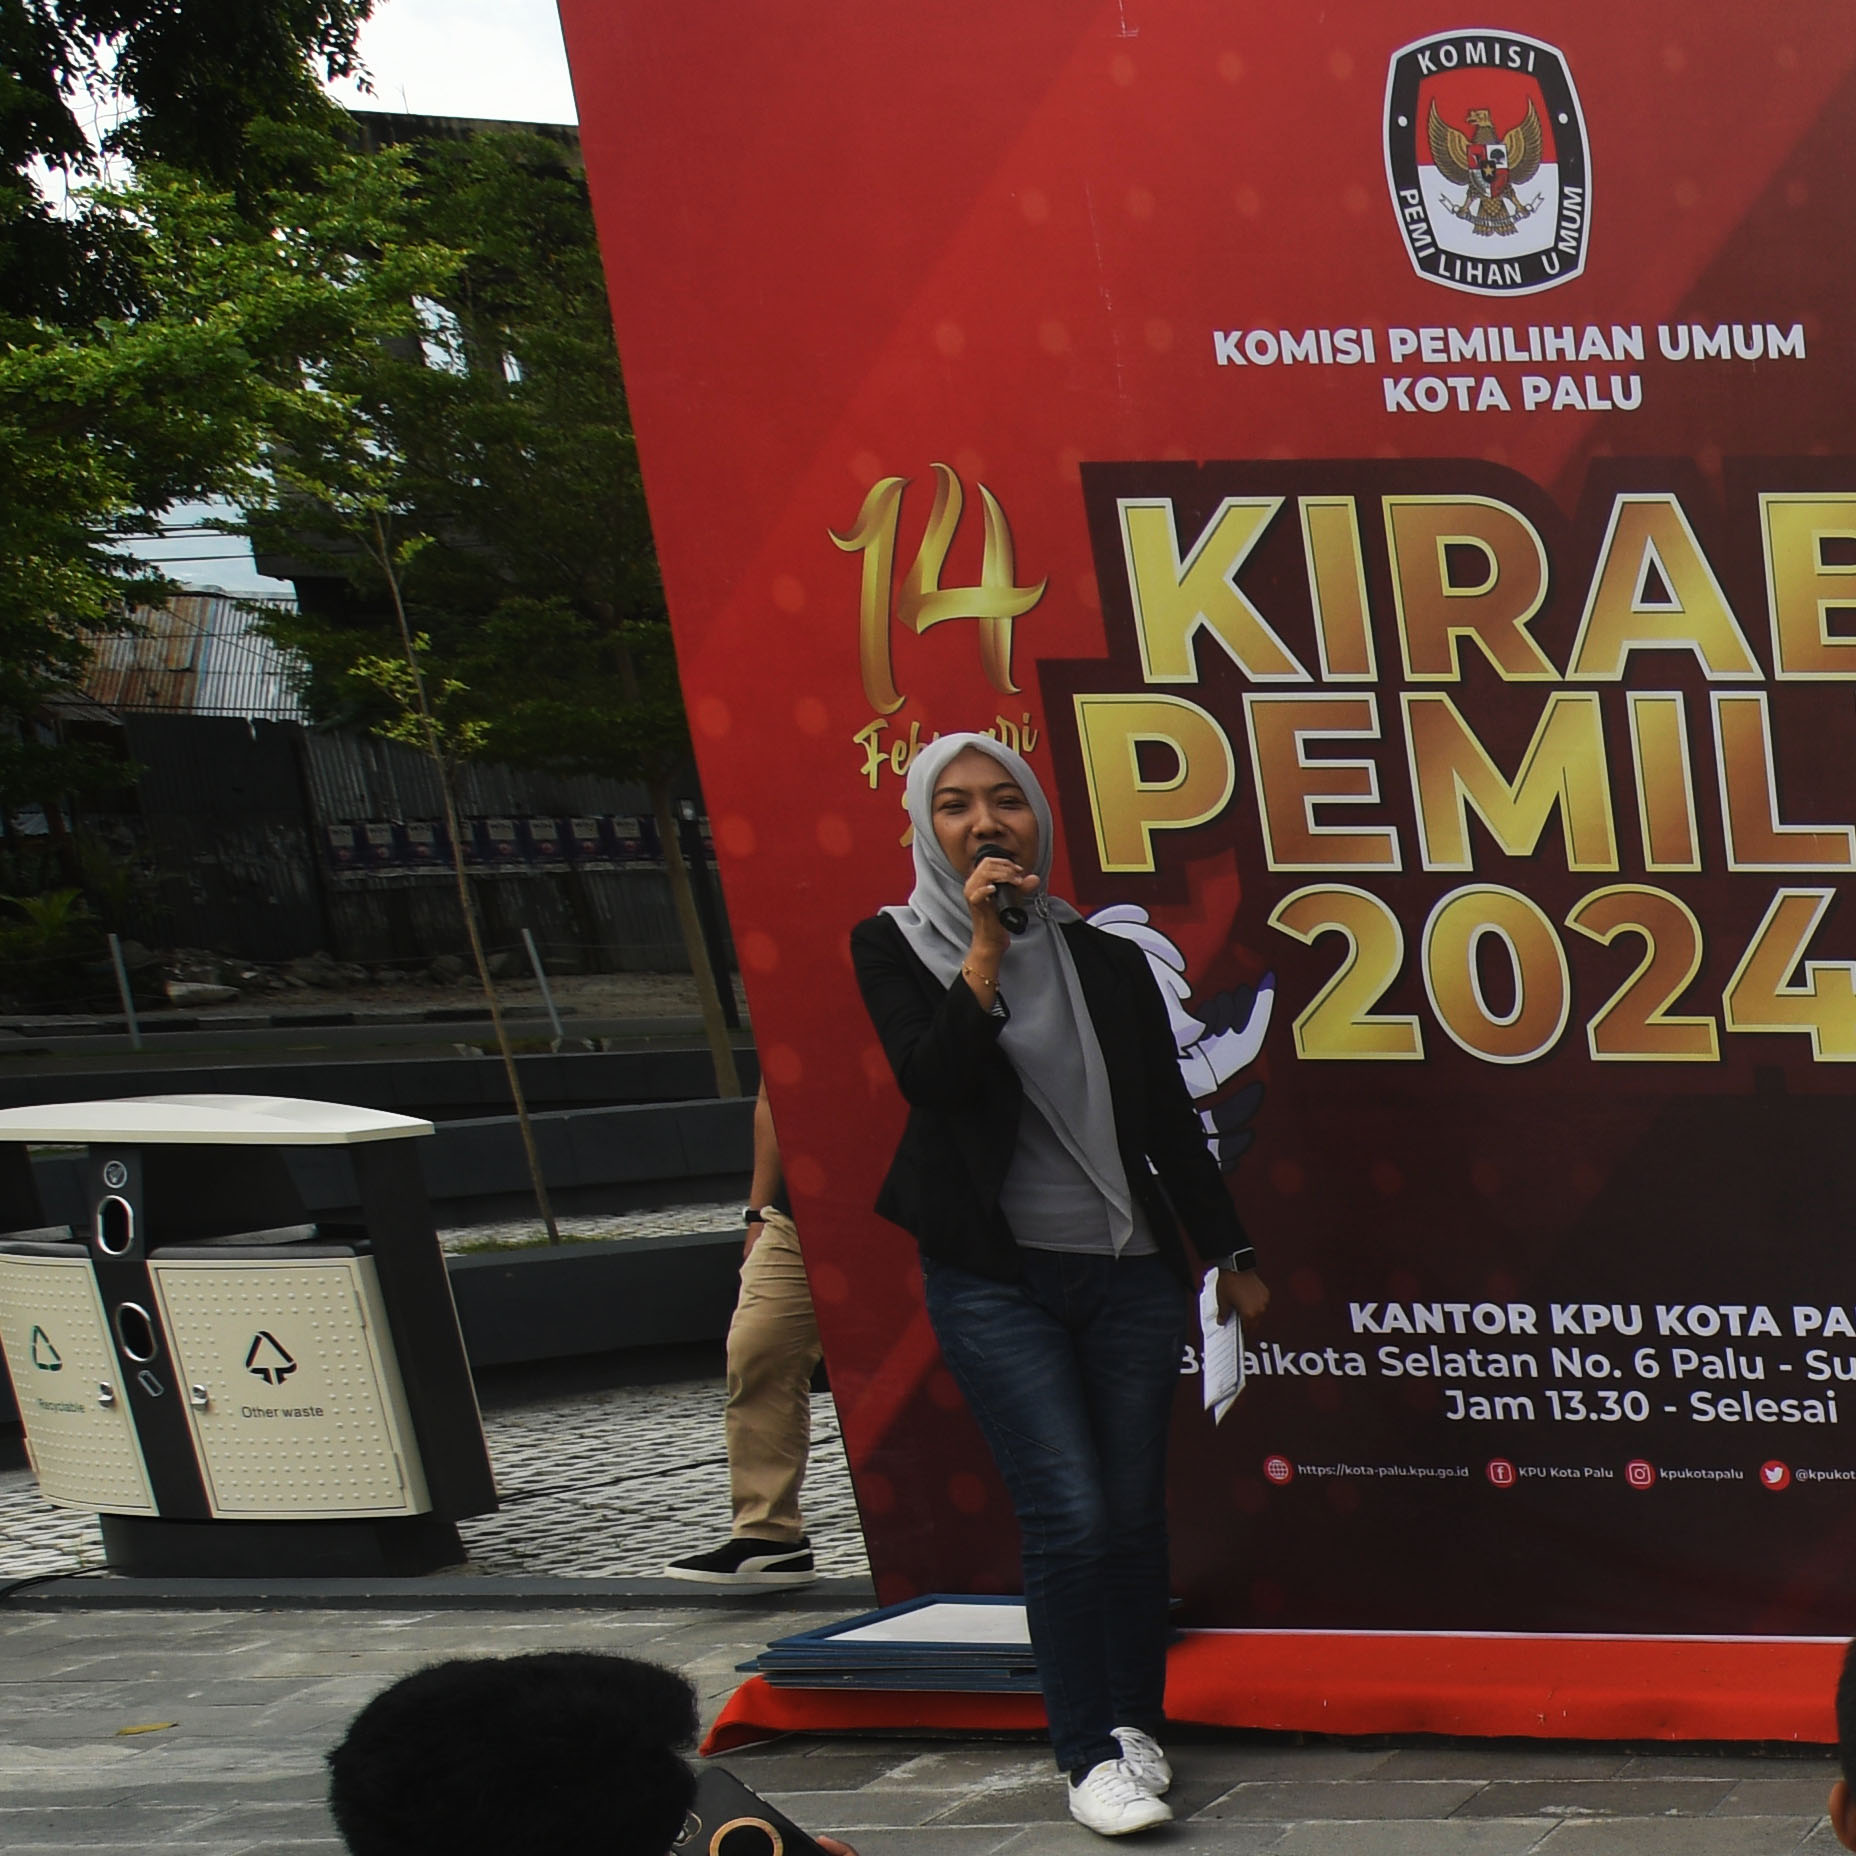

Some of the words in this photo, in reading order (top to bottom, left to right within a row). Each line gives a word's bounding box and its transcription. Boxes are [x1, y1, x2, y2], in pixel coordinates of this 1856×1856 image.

[1417, 41, 1537, 75] KOMISI
[1400, 187, 1523, 285] PEMILIHAN
[1213, 328, 1374, 366] KOMISI
[1389, 326, 1644, 364] PEMILIHAN
[1659, 325, 1805, 361] UMUM
[1384, 376, 1510, 413] KOTA
[1522, 375, 1643, 412] PALU
[827, 462, 1047, 714] 14
[1350, 1302, 1538, 1335] KANTOR
[1550, 1304, 1643, 1336] KPU
[1656, 1305, 1782, 1337] KOTA
[1379, 1344, 1544, 1378] Selatan
[1551, 1348, 1622, 1378] No.
[1634, 1348, 1660, 1379] 6
[1672, 1347, 1765, 1380] Palu
[241, 1406, 279, 1419] Other
[281, 1405, 324, 1418] waste
[1445, 1389, 1535, 1421] Jam
[1545, 1390, 1650, 1422] 13.30
[1690, 1391, 1839, 1424] Selesai
[1519, 1467, 1547, 1478] KPU
[1550, 1467, 1580, 1479] Kota
[1583, 1467, 1614, 1479] Palu
[1660, 1467, 1744, 1482] kpukotapalu
